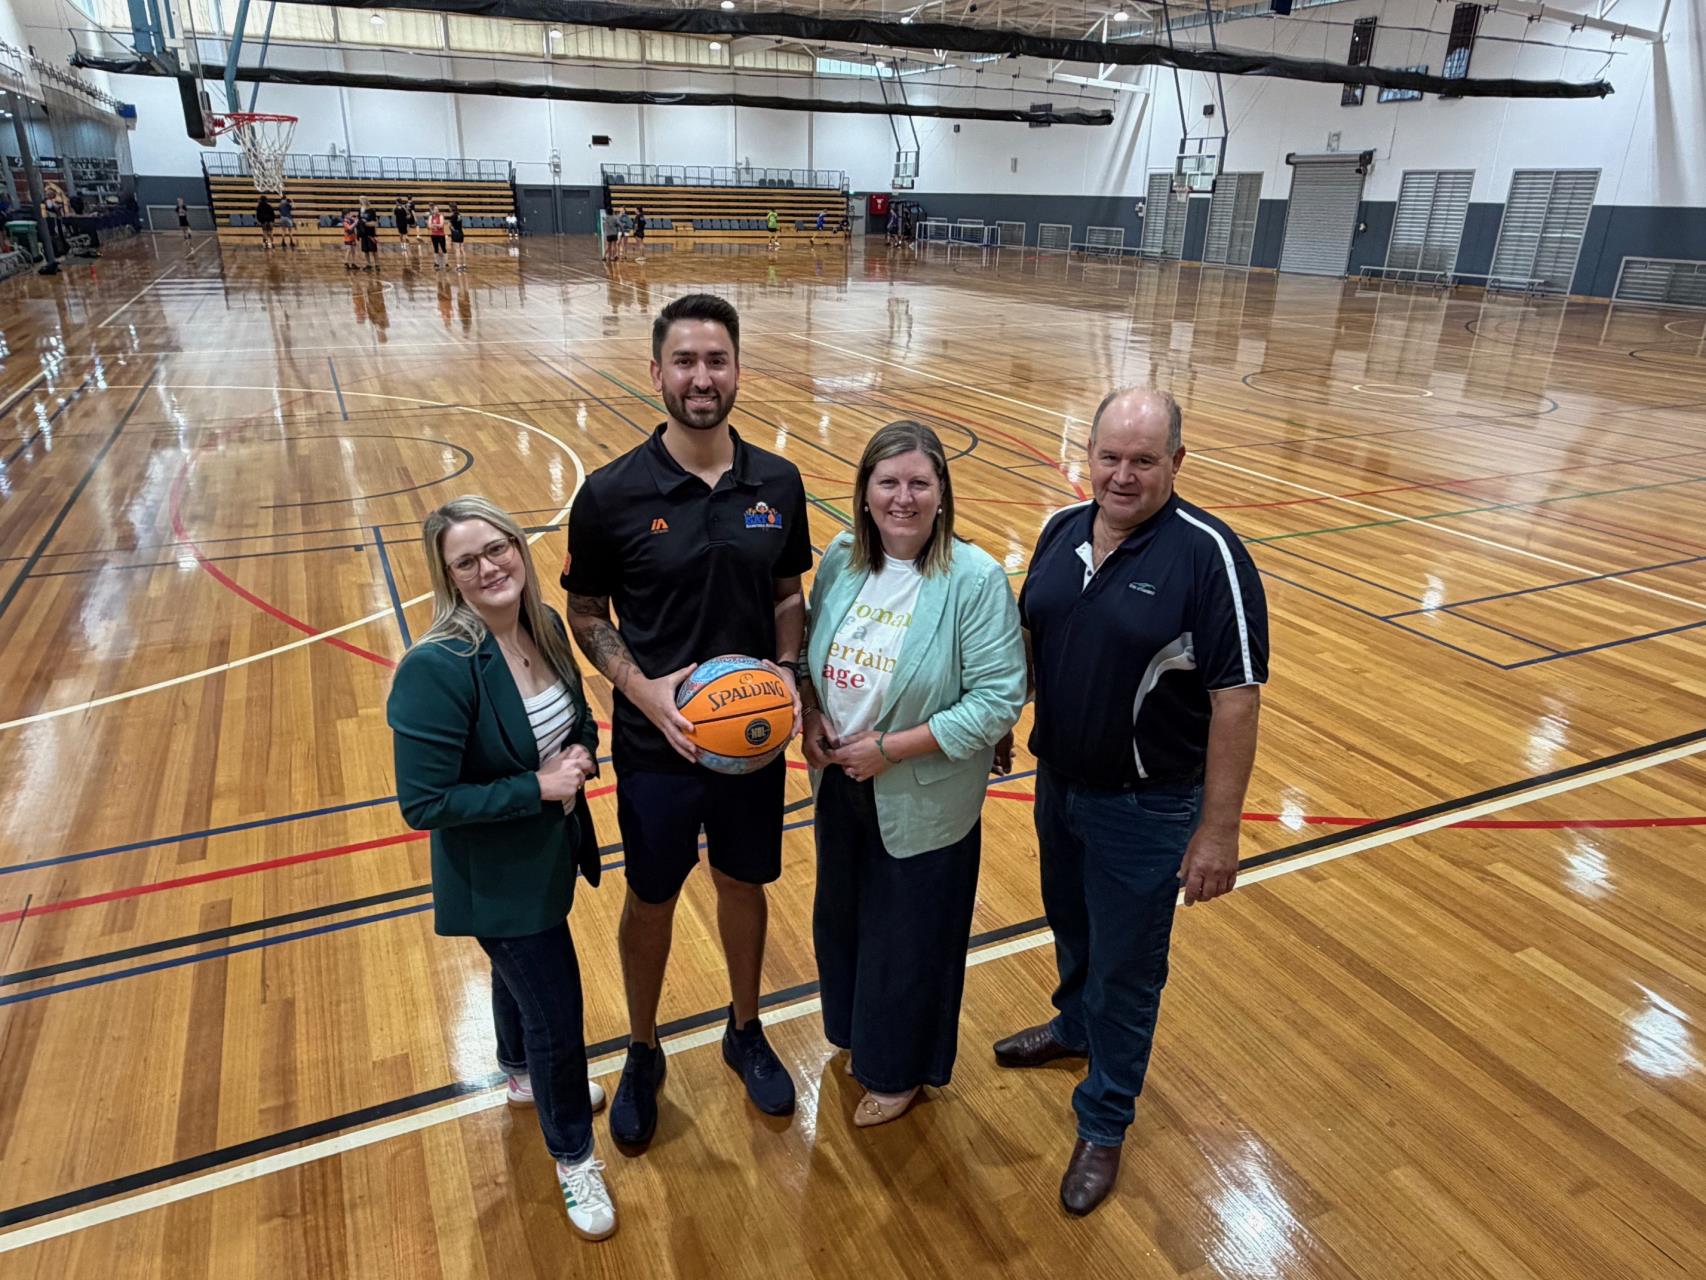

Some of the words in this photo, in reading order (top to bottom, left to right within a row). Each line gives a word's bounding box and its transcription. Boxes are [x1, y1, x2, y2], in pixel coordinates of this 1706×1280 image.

[828, 641, 897, 674] ertain
[822, 663, 865, 689] age
[707, 681, 785, 712] SPALDING
